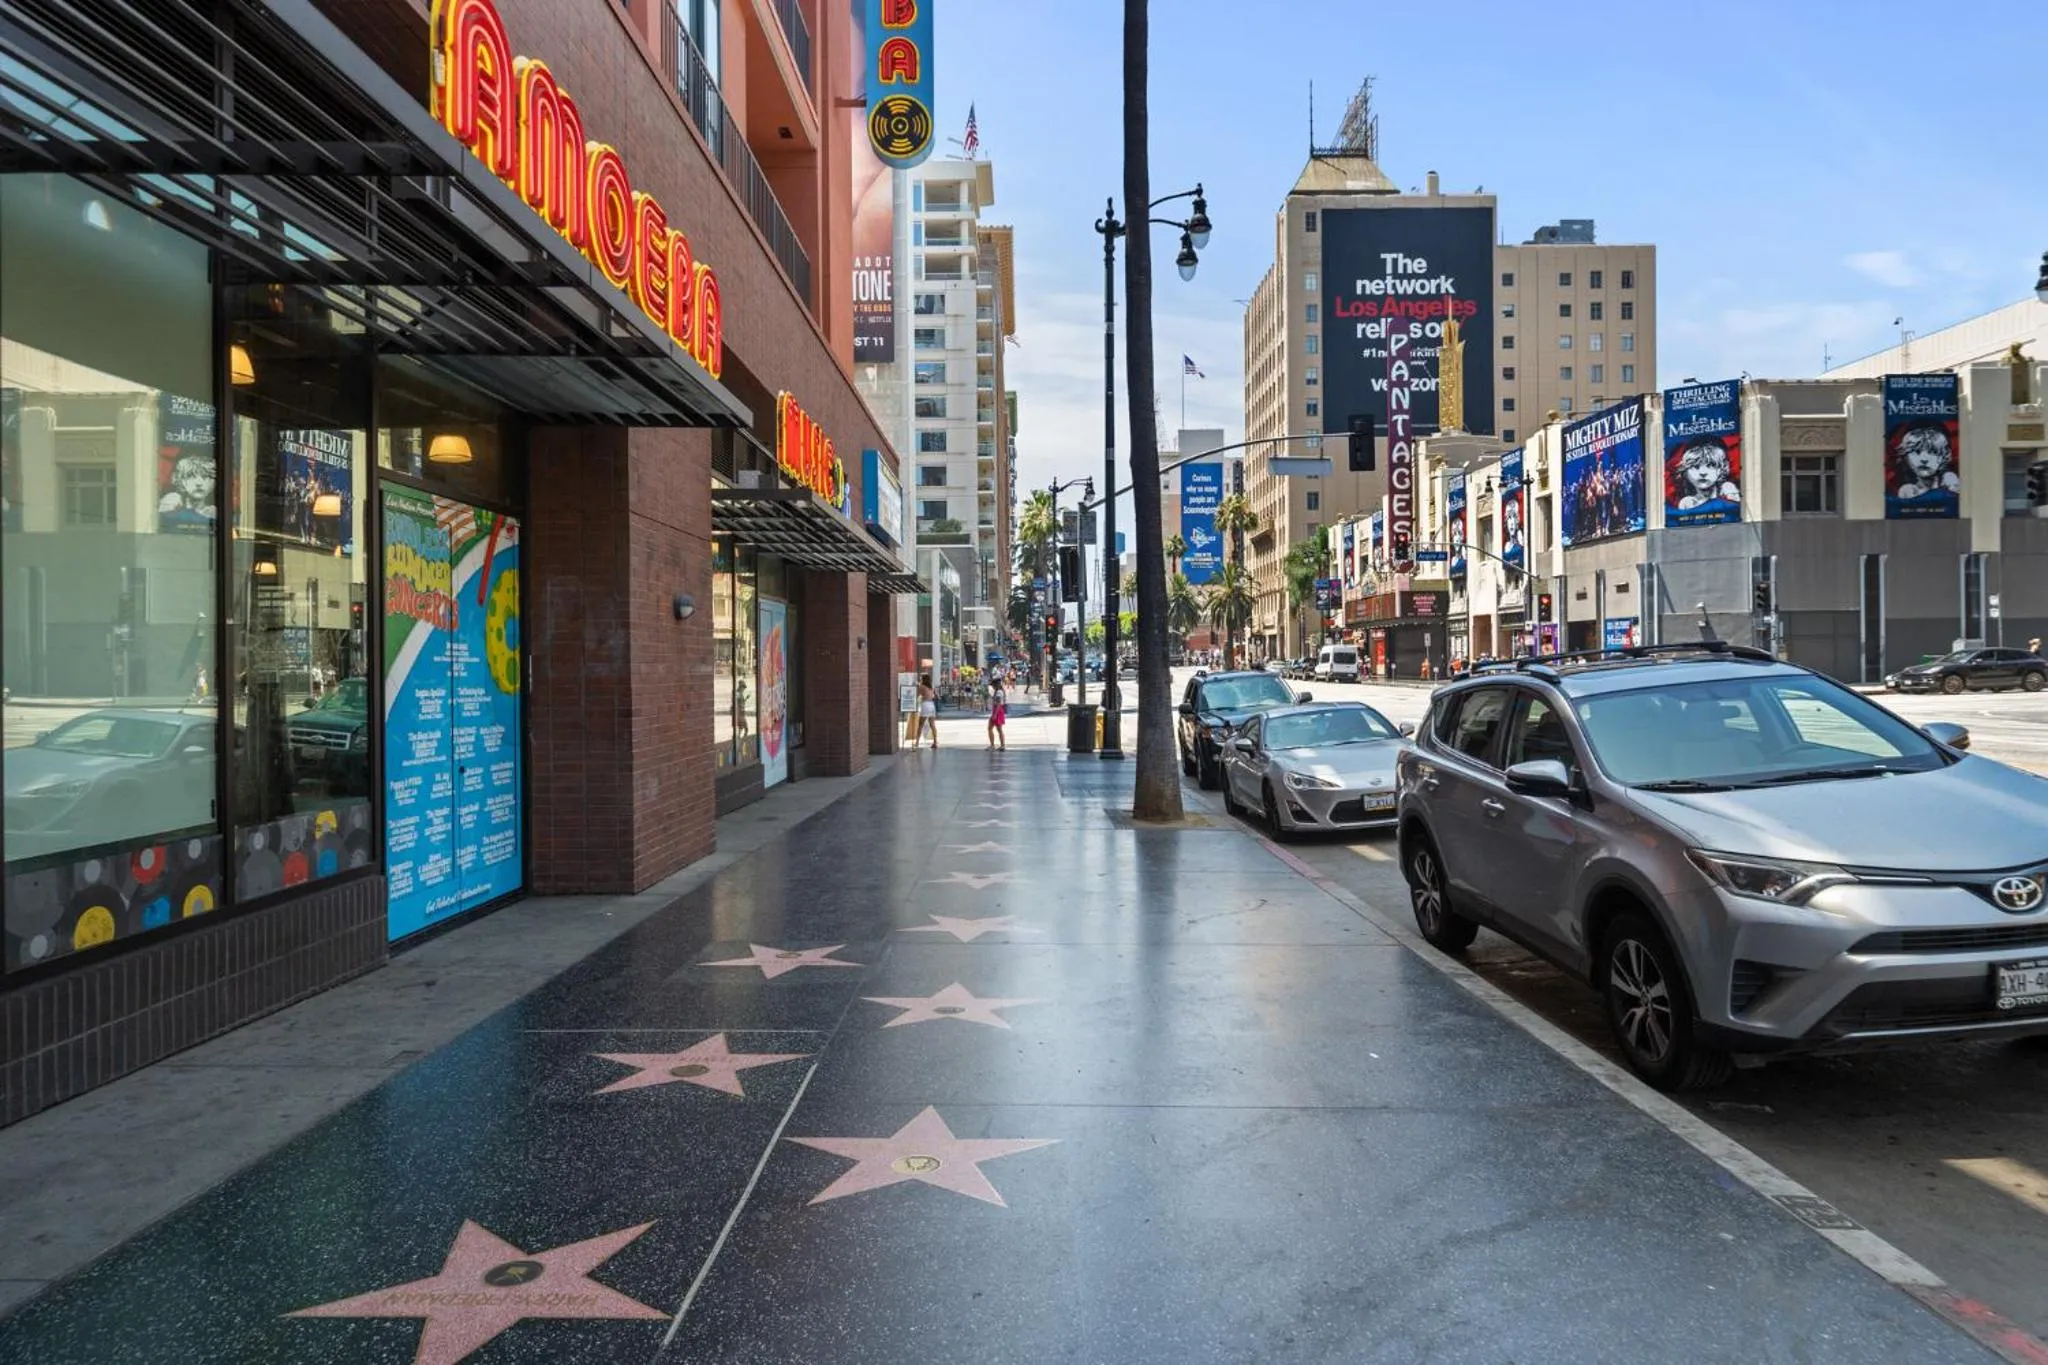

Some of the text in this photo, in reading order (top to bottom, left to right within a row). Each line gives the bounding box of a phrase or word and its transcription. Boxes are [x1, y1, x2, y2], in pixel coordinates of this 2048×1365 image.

[430, 0, 722, 381] AMOEBA
[1380, 253, 1427, 274] The
[1356, 275, 1456, 295] network
[1335, 295, 1477, 320] Los Angeles
[1356, 318, 1422, 338] rels
[1613, 404, 1640, 432] MIZ
[1668, 418, 1736, 437] Misérables
[1391, 334, 1411, 543] PANTAGES
